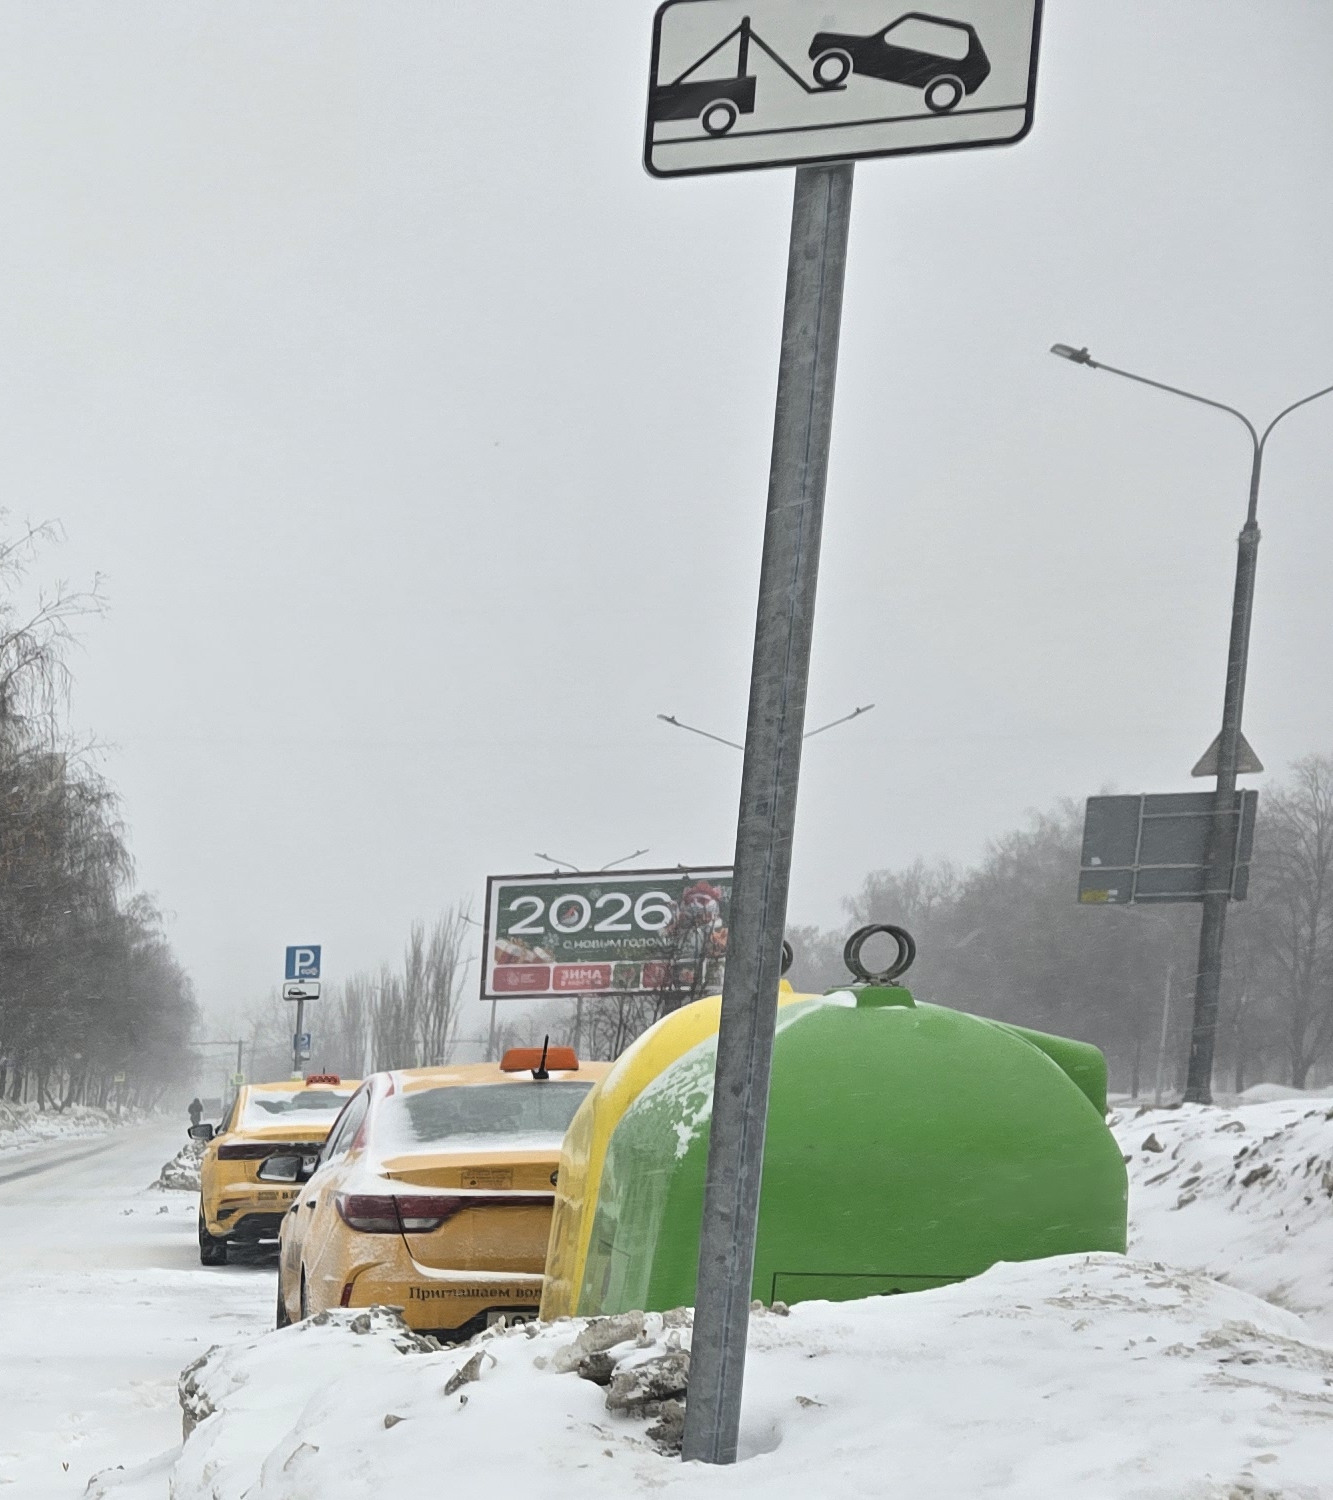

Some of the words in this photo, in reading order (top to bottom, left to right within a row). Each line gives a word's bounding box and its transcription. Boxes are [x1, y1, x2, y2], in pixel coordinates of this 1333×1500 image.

[507, 891, 673, 935] 2026
[294, 949, 315, 976] P
[409, 1286, 510, 1300] Приглашаем
